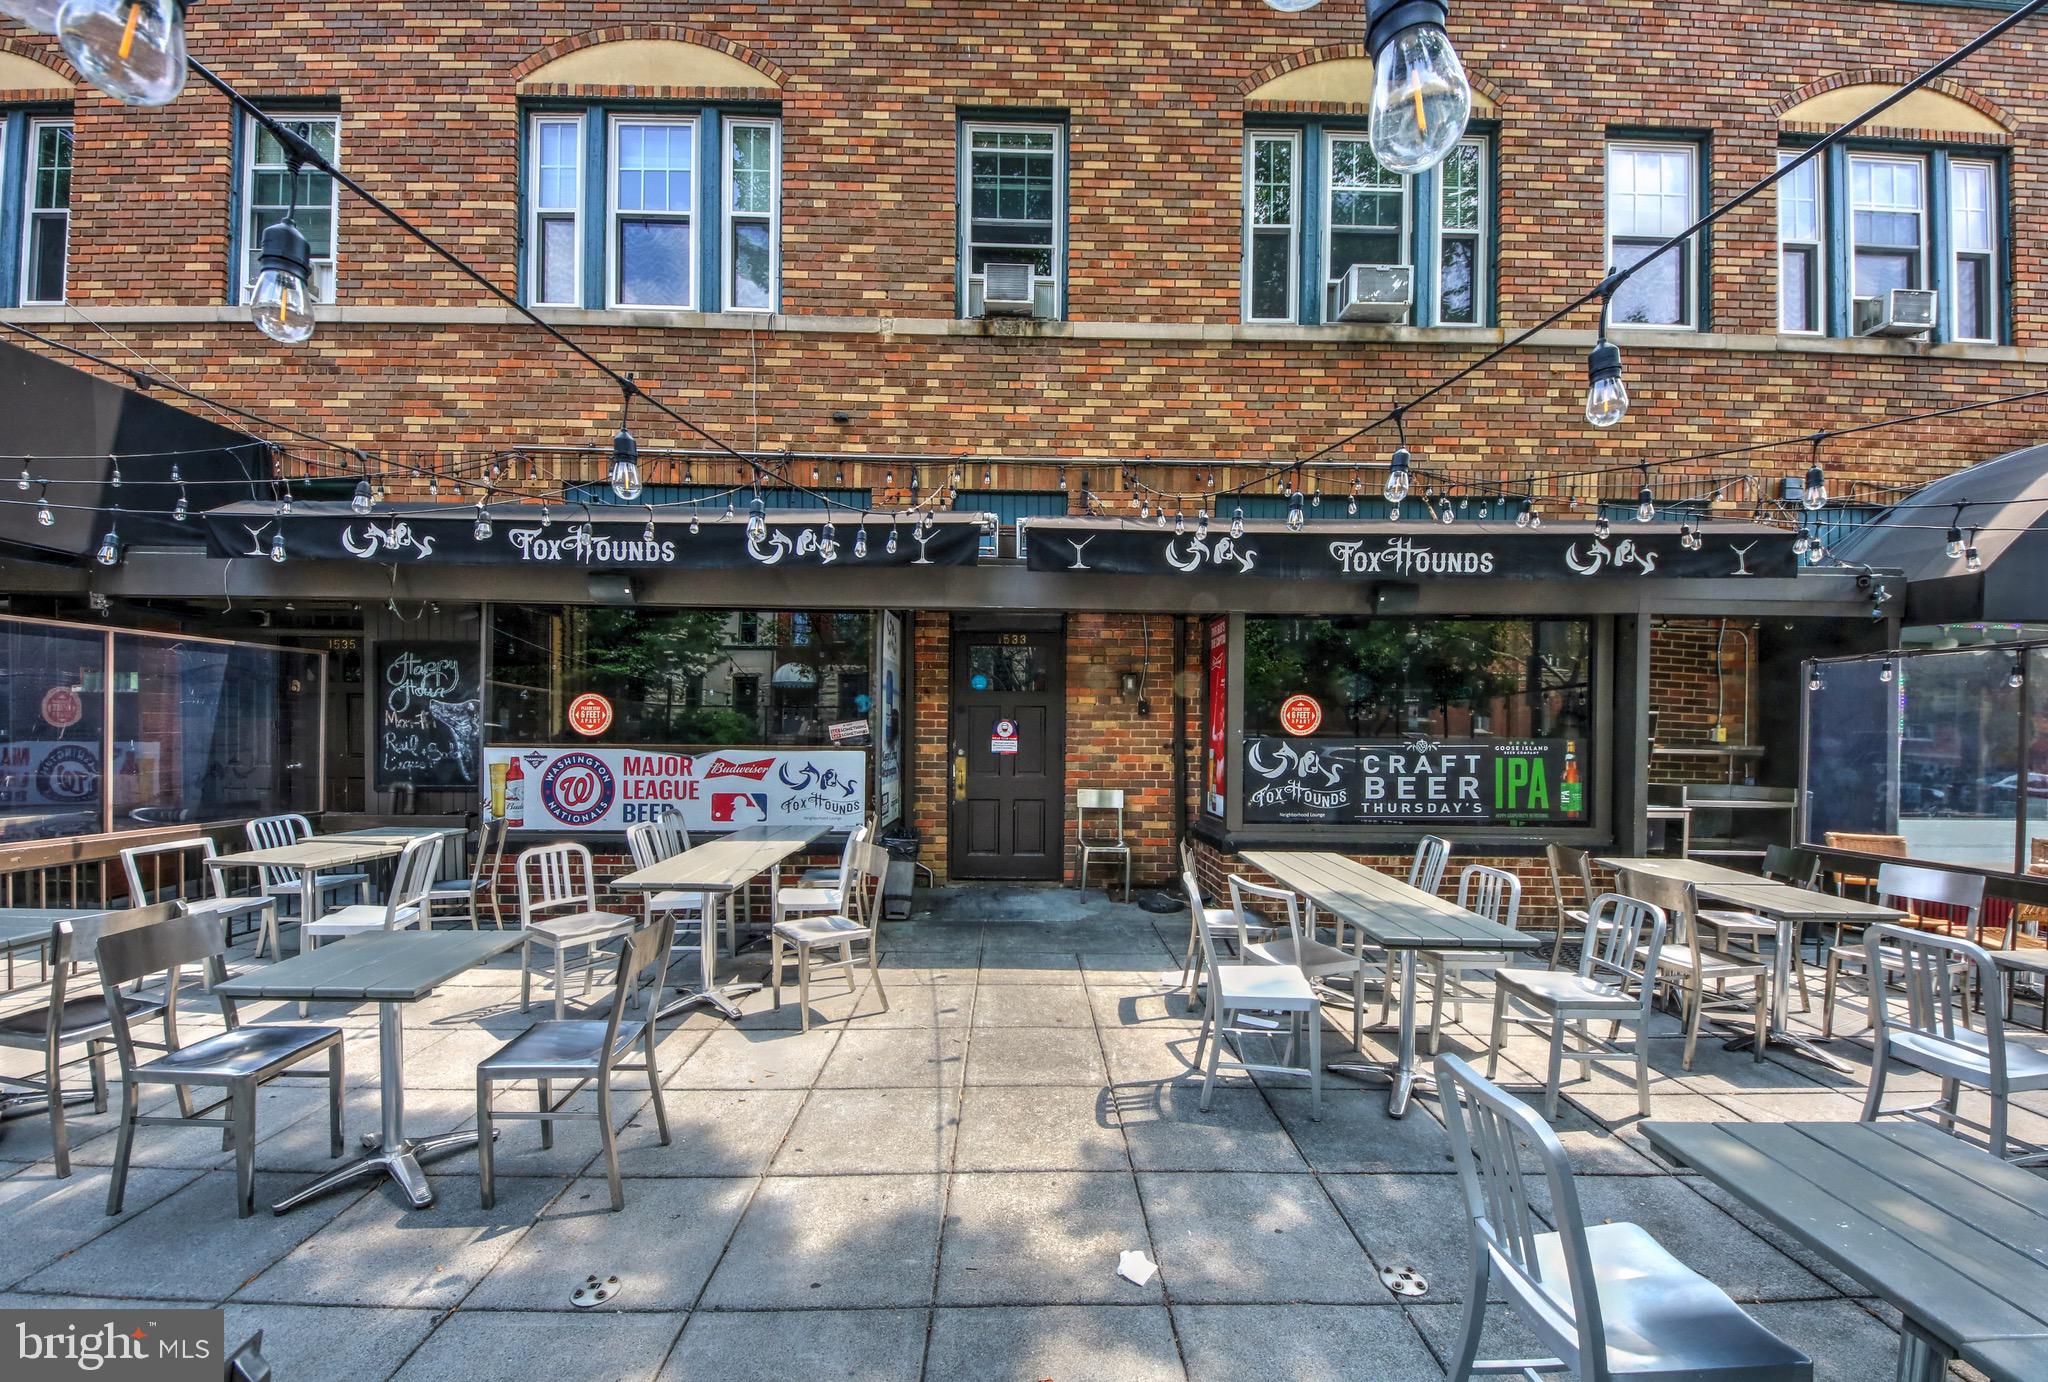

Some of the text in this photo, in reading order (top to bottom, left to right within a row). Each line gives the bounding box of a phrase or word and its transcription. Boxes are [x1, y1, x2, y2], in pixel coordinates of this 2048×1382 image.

[328, 639, 357, 650] 1535
[998, 634, 1027, 645] 1533
[386, 651, 460, 692] Happy
[388, 679, 446, 713] Hour
[586, 710, 601, 719] FEET
[1291, 711, 1311, 719] 6 FEET
[545, 755, 612, 784] WASHINGTON
[623, 756, 693, 777] MAJOR
[711, 762, 769, 774] Budweiser
[1363, 755, 1481, 774] CRAFT
[559, 772, 595, 807] W
[622, 780, 700, 800] LEAGUE
[1365, 776, 1480, 800] BEER
[1495, 757, 1550, 809] IPA
[1561, 790, 1570, 803] IPA
[547, 801, 609, 824] NATIONALS
[1361, 802, 1483, 813] THURSDAY'S
